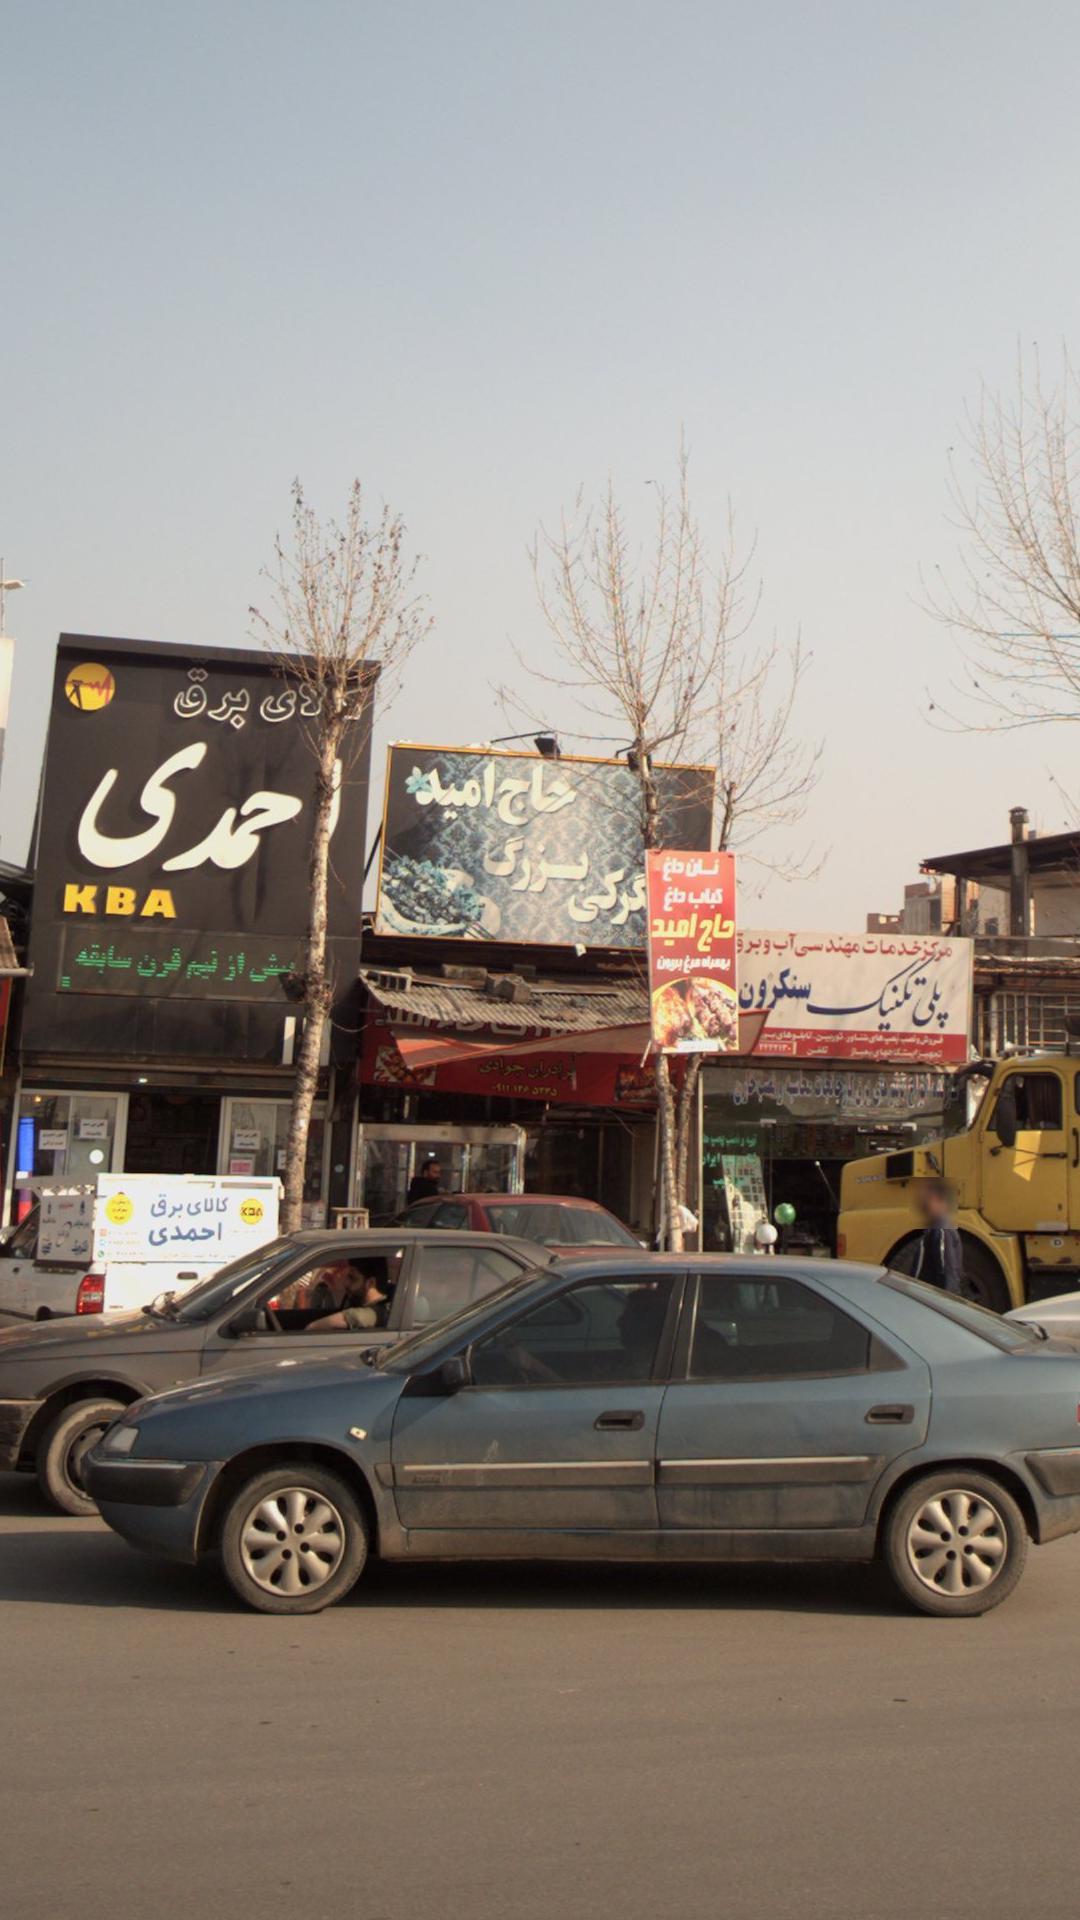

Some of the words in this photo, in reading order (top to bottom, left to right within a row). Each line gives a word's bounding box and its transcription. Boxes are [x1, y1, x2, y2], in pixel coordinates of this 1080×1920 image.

[174, 667, 250, 729] برق
[415, 760, 496, 820] امید
[498, 764, 577, 826] حاج
[484, 836, 589, 892] بزرگ
[663, 857, 684, 881] داغ
[686, 858, 719, 877] نان
[64, 884, 176, 919] KBA
[664, 887, 686, 911] داغ
[688, 888, 723, 909] کباب
[651, 913, 698, 946] امید
[697, 913, 735, 952] حاج
[773, 933, 797, 957] آب
[795, 937, 859, 958] مهندسی
[862, 940, 921, 956] خدمات
[921, 941, 952, 962] مرکز
[75, 944, 132, 974] سابقه
[137, 948, 182, 977] قرن
[187, 950, 217, 979] نیم
[224, 952, 245, 981] از
[683, 955, 700, 973] مرغ
[912, 979, 948, 1028] پلی
[151, 1194, 183, 1218] برق
[187, 1197, 228, 1216] کالای
[148, 1222, 222, 1246] احمدی
